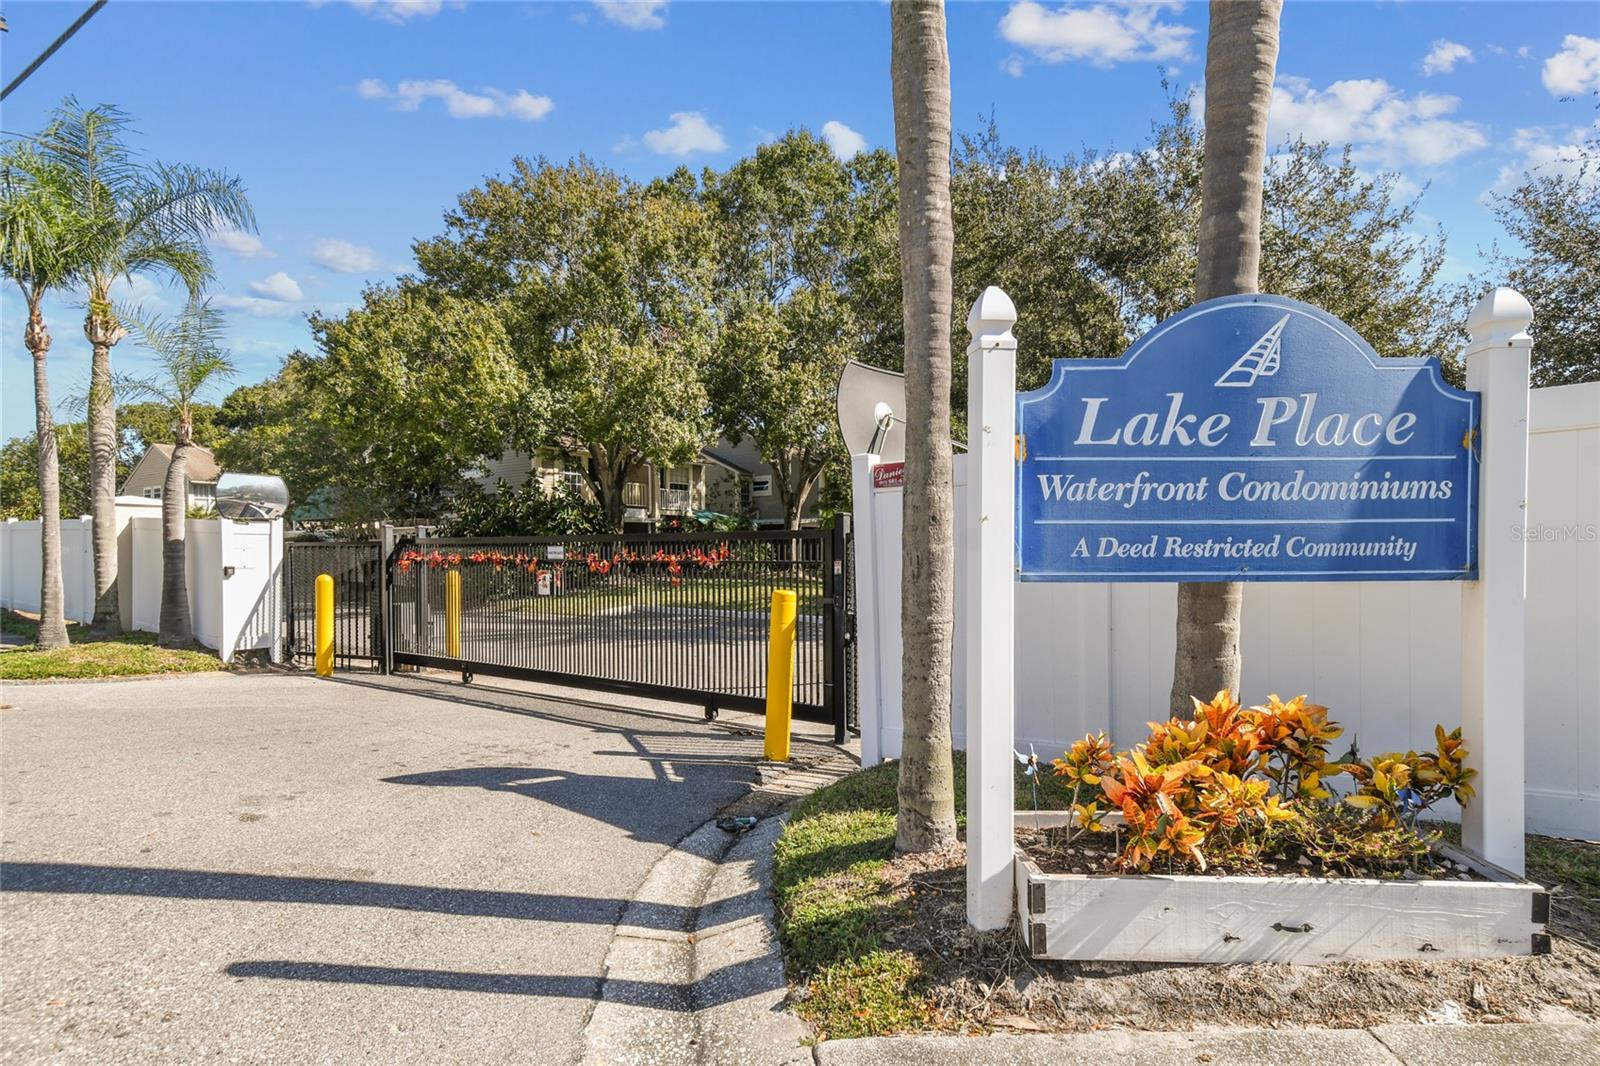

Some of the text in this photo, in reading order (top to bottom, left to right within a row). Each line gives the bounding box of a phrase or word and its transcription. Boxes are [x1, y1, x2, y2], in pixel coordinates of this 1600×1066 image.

[1074, 392, 1417, 447] Lake Place
[1037, 470, 1453, 509] Waterfront Condominiums
[1070, 534, 1417, 562] A Deed Restricted Community
